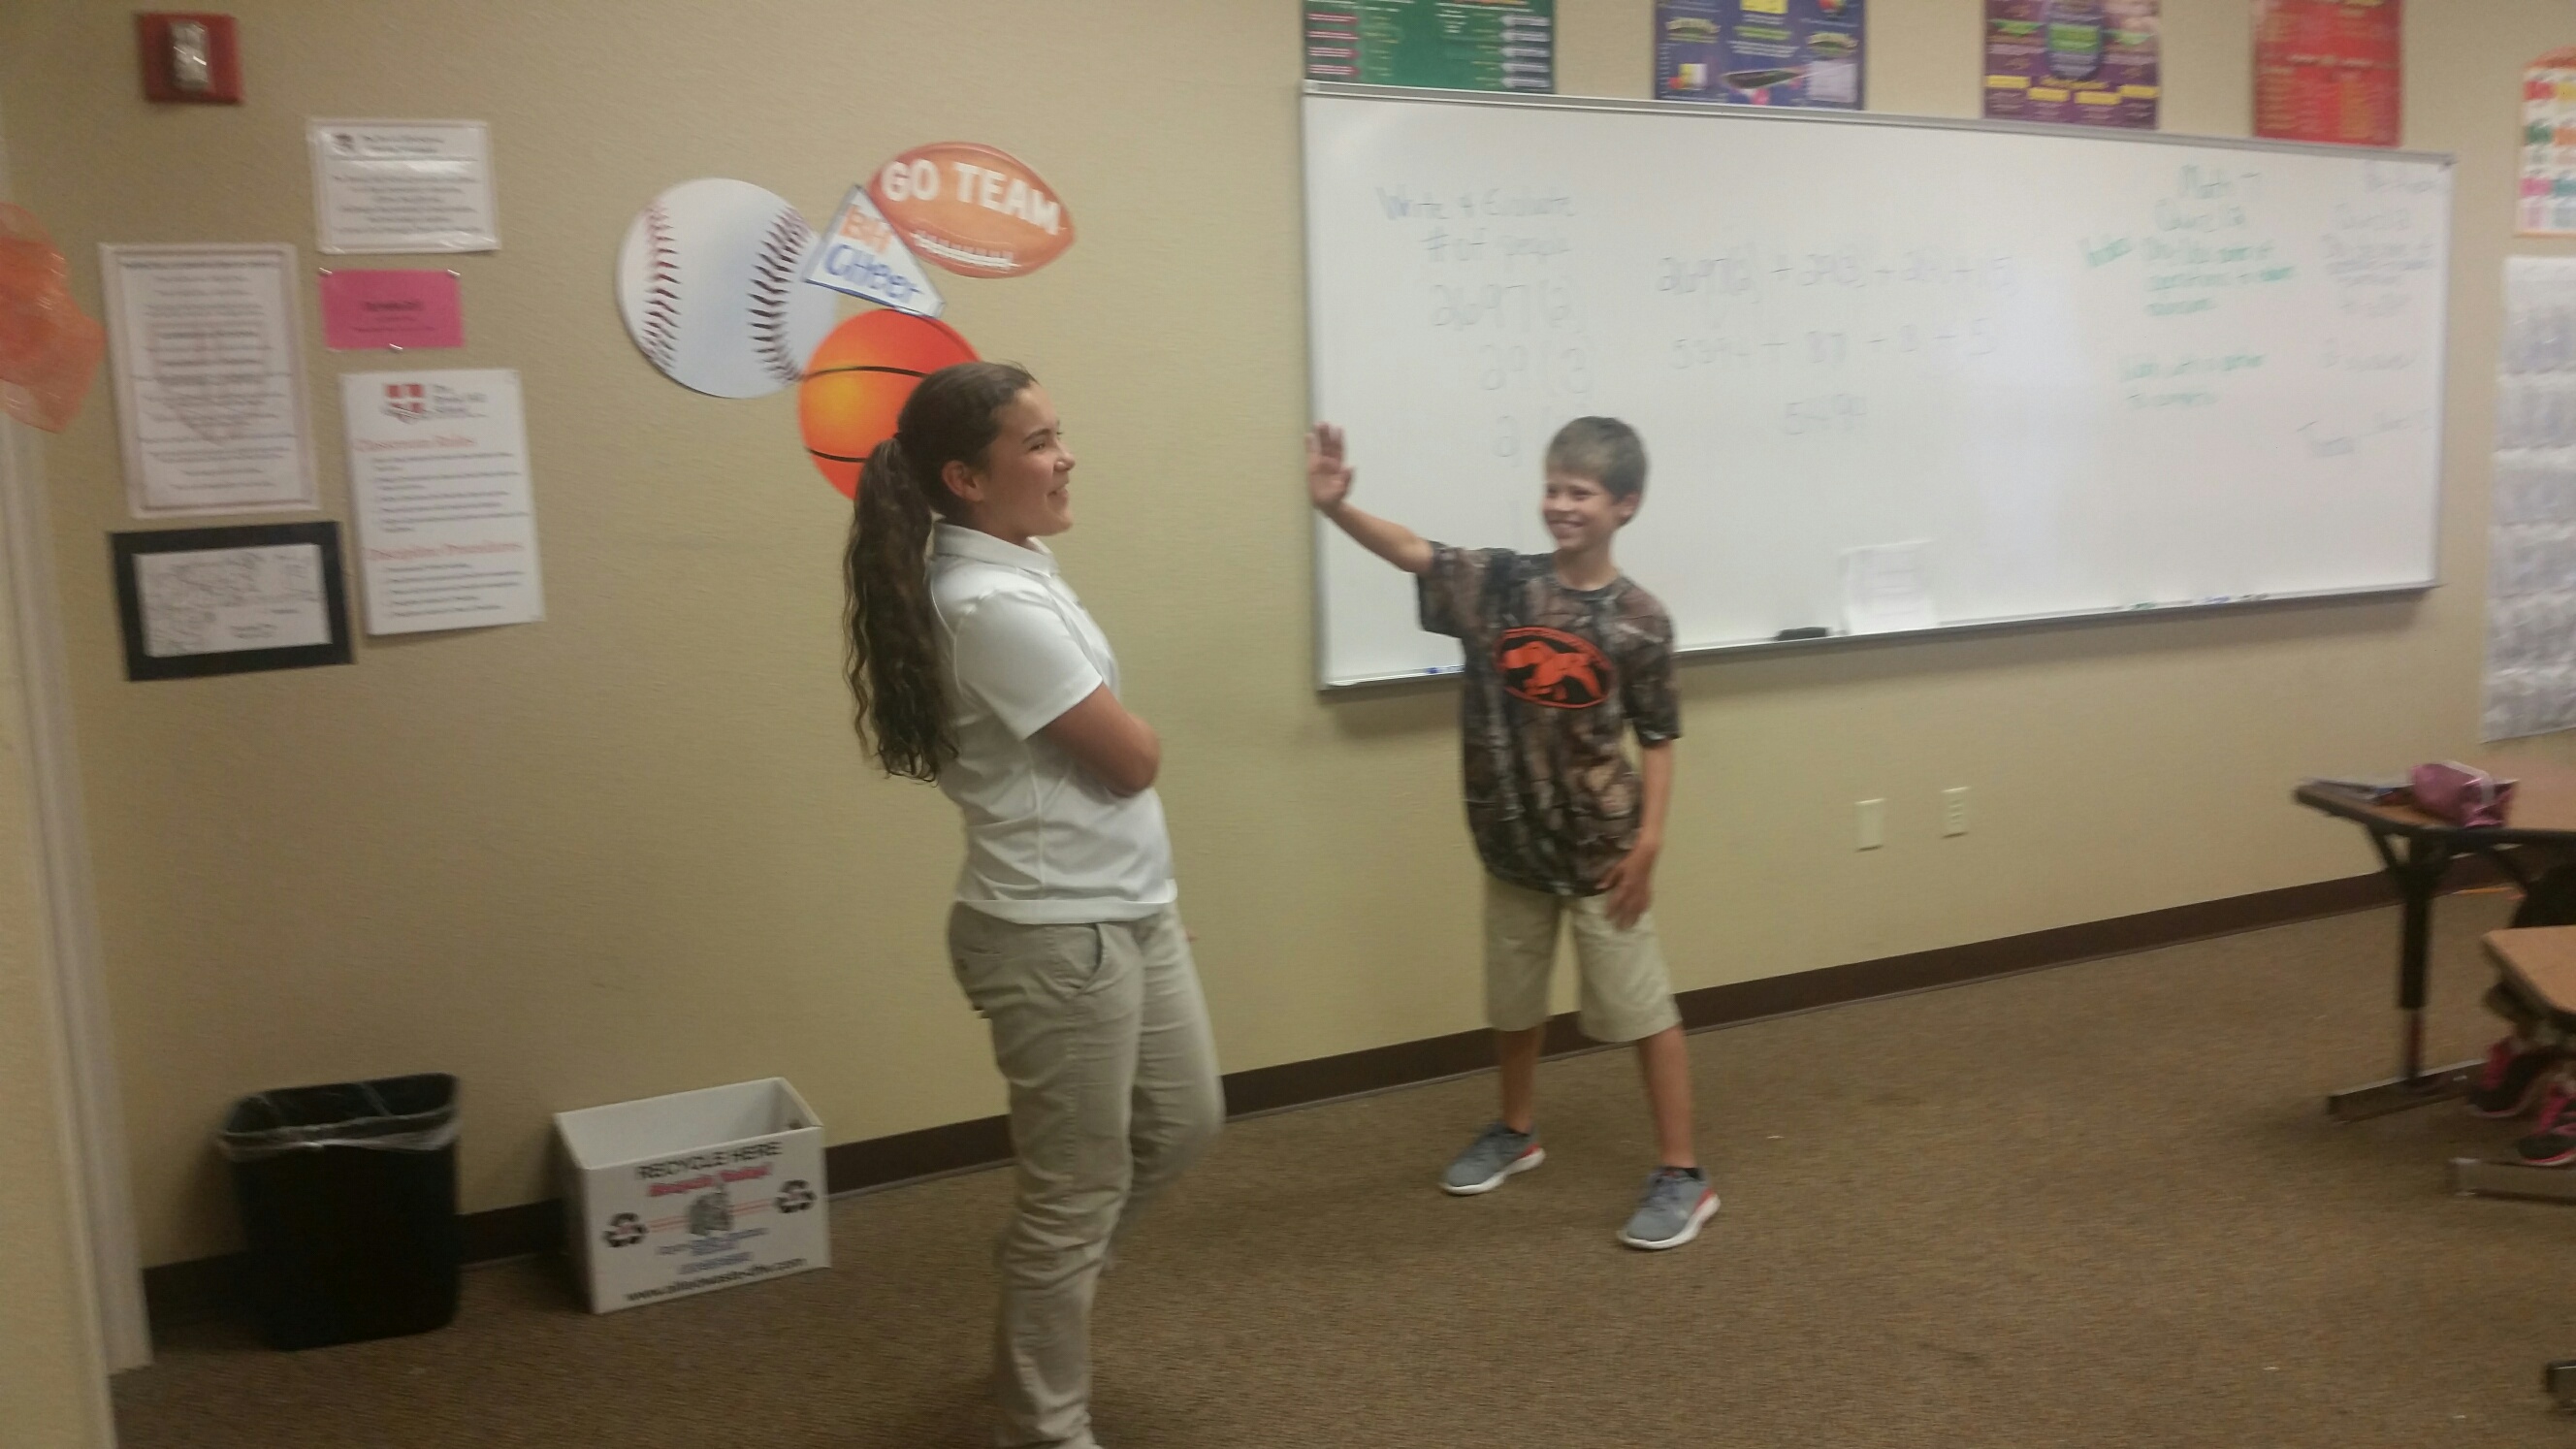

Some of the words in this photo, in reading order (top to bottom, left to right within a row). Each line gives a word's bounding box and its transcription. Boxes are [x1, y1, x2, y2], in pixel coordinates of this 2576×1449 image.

[881, 158, 942, 203] GO
[952, 160, 1062, 236] TEAM
[636, 1148, 727, 1180] RECYCLE
[731, 1141, 784, 1163] HERE
